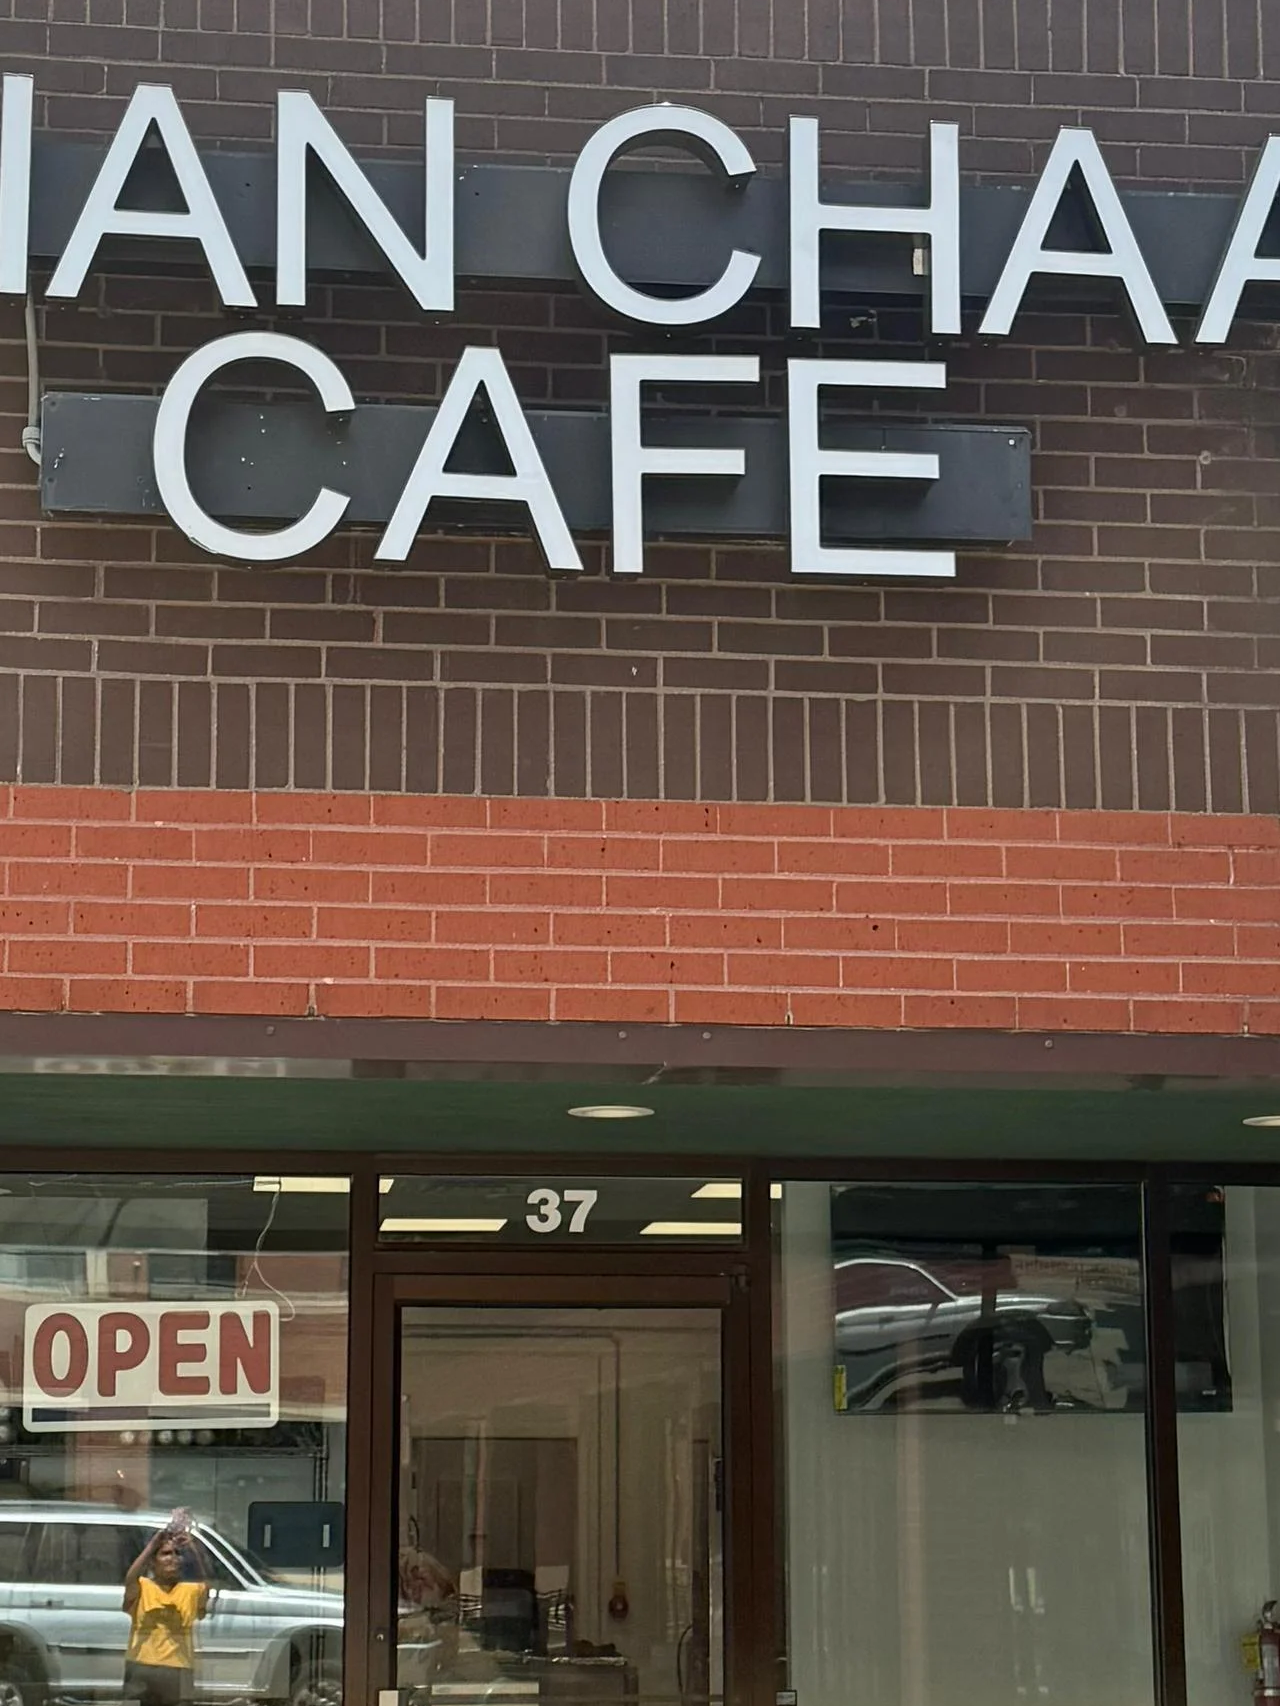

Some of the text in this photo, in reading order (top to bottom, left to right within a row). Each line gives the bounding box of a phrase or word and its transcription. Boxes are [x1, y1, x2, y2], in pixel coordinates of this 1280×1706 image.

[152, 331, 957, 578] CAFE
[525, 1188, 598, 1233] 37
[32, 1310, 272, 1398] OPEN
